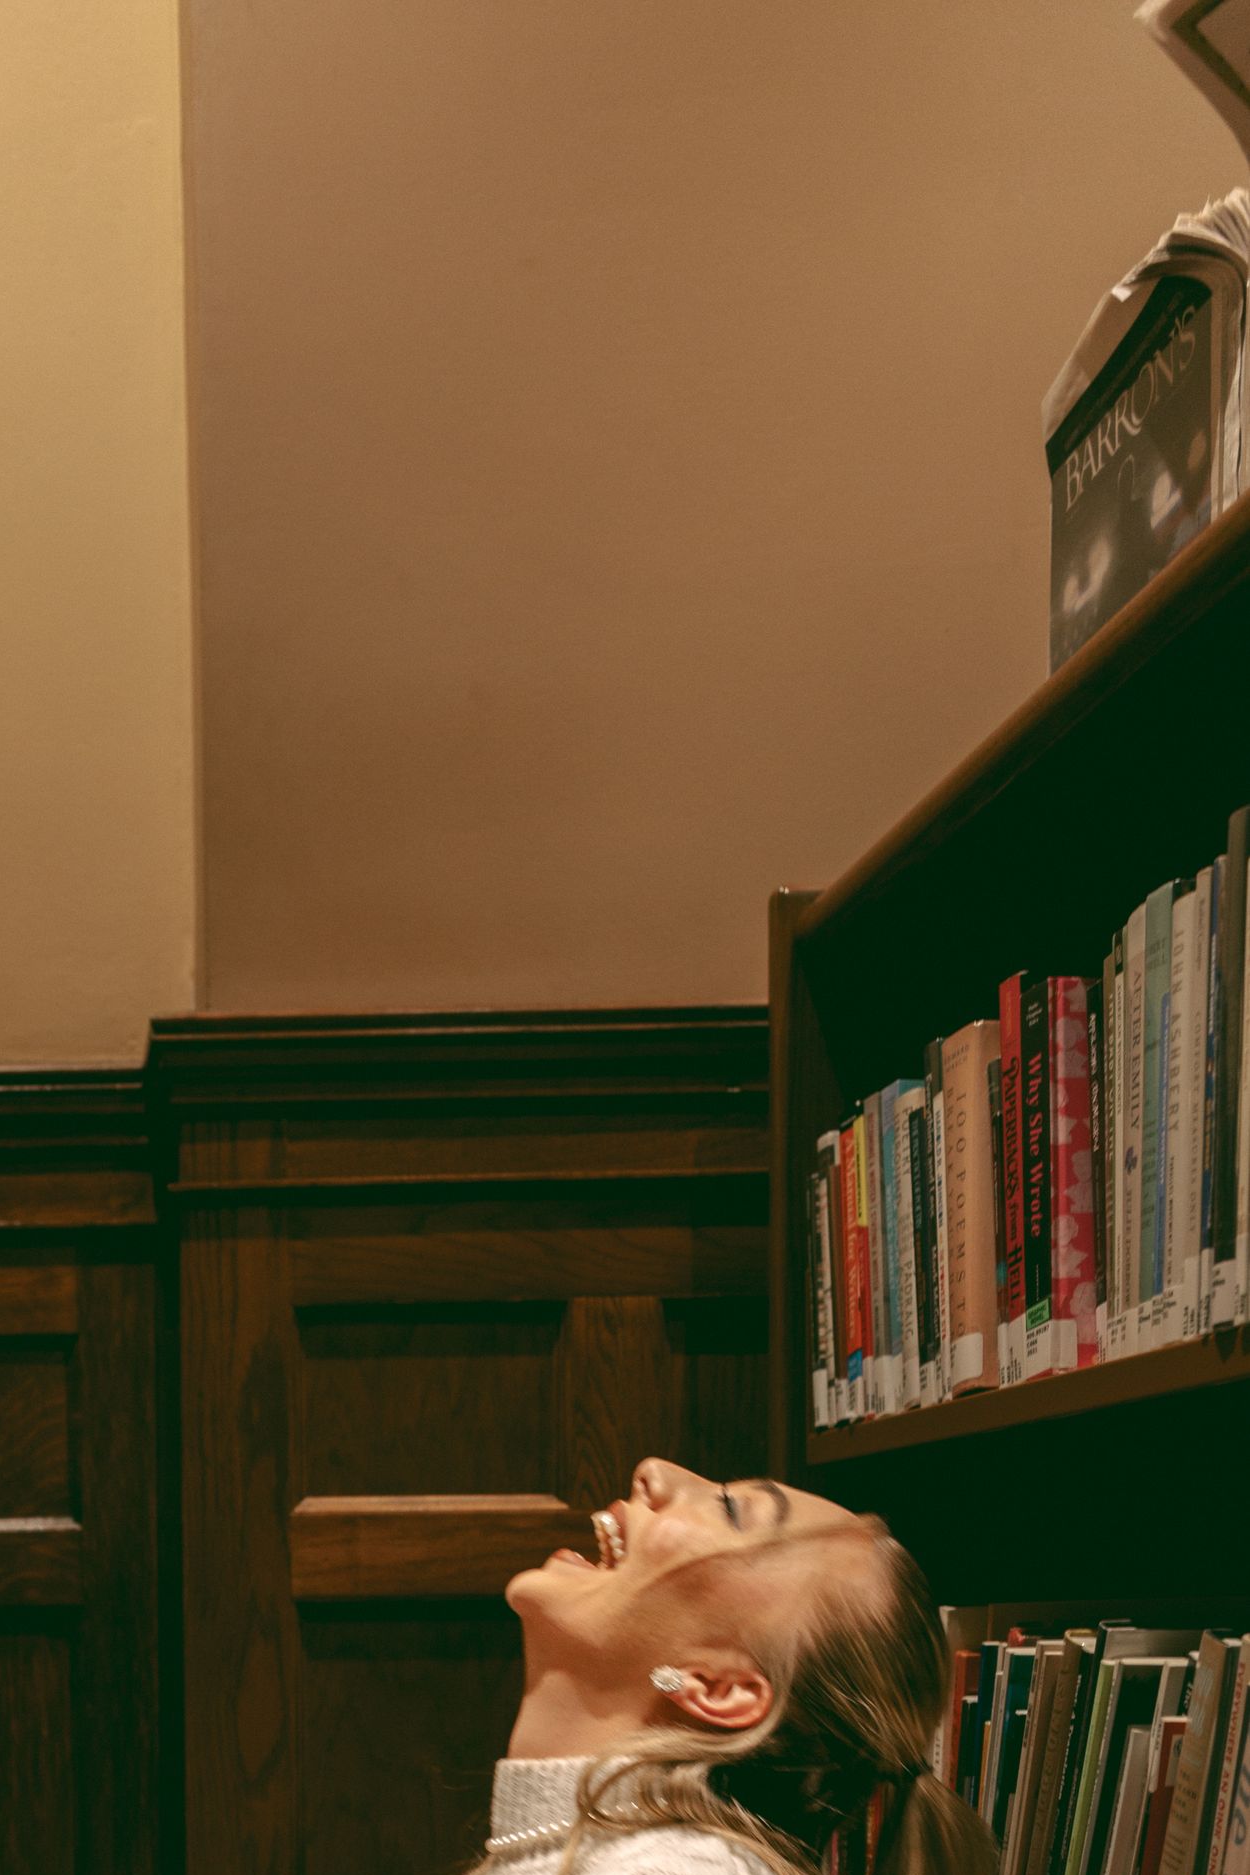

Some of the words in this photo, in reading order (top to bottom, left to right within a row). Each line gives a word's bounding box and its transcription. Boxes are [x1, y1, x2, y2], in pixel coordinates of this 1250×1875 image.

[1065, 305, 1197, 513] BARRON'S
[1172, 929, 1184, 995] JOHN
[1132, 970, 1142, 1048] AFTER
[1027, 1052, 1043, 1106] Why
[1130, 1056, 1141, 1131] EMILY
[1168, 1012, 1181, 1132] ASHBERY
[901, 1106, 912, 1176] POETRY
[956, 1093, 967, 1153] 100
[1001, 1056, 1019, 1200] PAPERBACKS
[1029, 1111, 1043, 1157] She
[845, 1155, 857, 1230] Manual
[956, 1169, 967, 1282] POEMS
[1029, 1161, 1043, 1238] Wrote
[846, 1233, 857, 1261] for
[1008, 1244, 1023, 1300] HELL
[847, 1269, 858, 1340] Writers
[956, 1299, 967, 1336] TO
[1226, 1661, 1246, 1764] EVERYWHERE
[1220, 1771, 1230, 1793] AN
[1213, 1798, 1226, 1840] OINK
